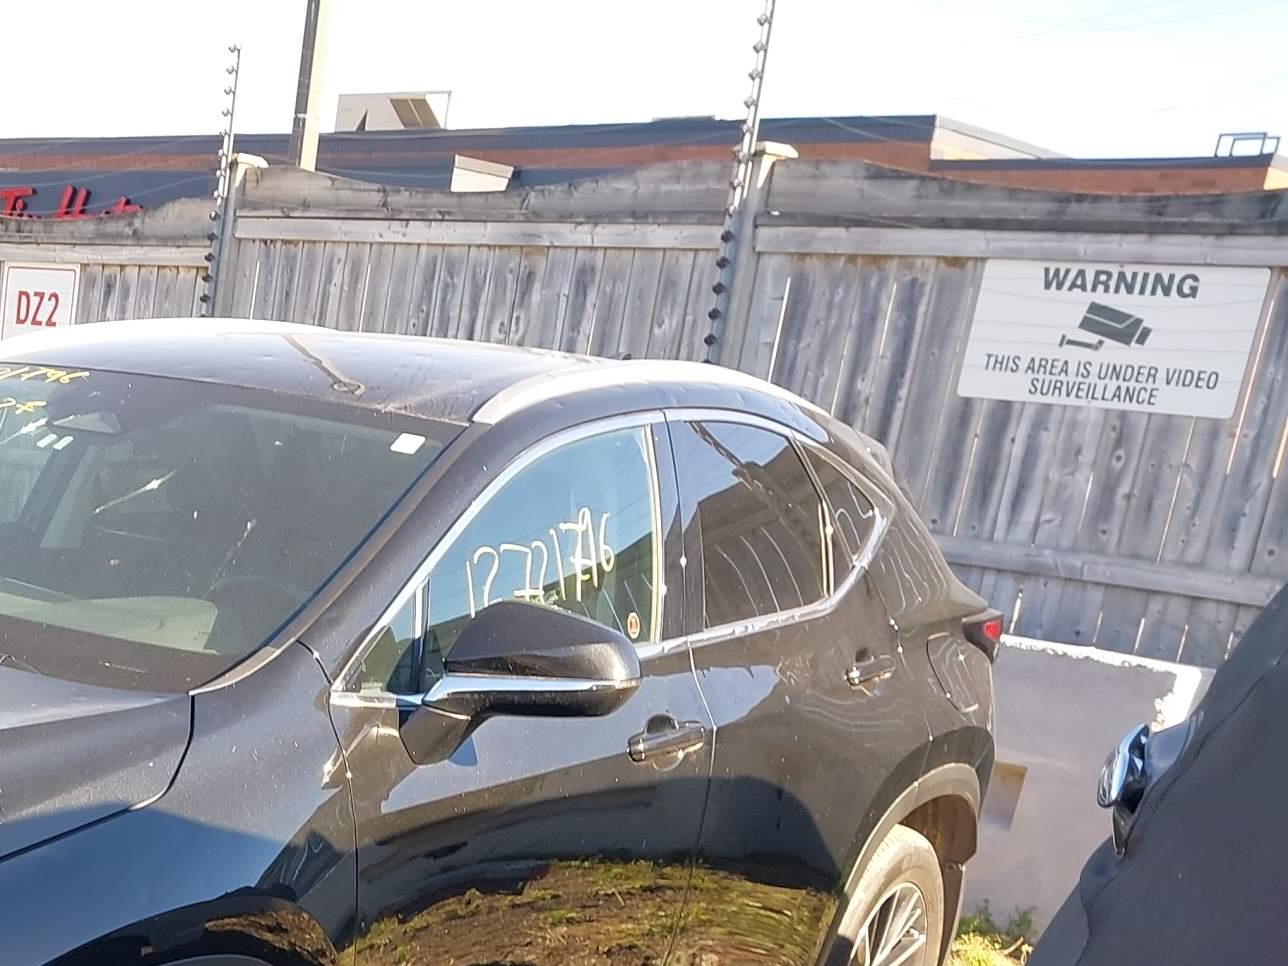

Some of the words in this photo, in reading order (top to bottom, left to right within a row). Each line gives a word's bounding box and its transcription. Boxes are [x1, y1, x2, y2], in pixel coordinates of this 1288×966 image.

[1043, 266, 1200, 299] WARNING
[15, 290, 60, 327] DZ2
[985, 353, 1021, 373] THIS
[1025, 356, 1070, 378] AREA
[1075, 361, 1093, 380] IS
[1098, 363, 1158, 385] UNDER
[1165, 368, 1219, 390] VIDEO
[1028, 378, 1160, 406] SURVEILLANCE
